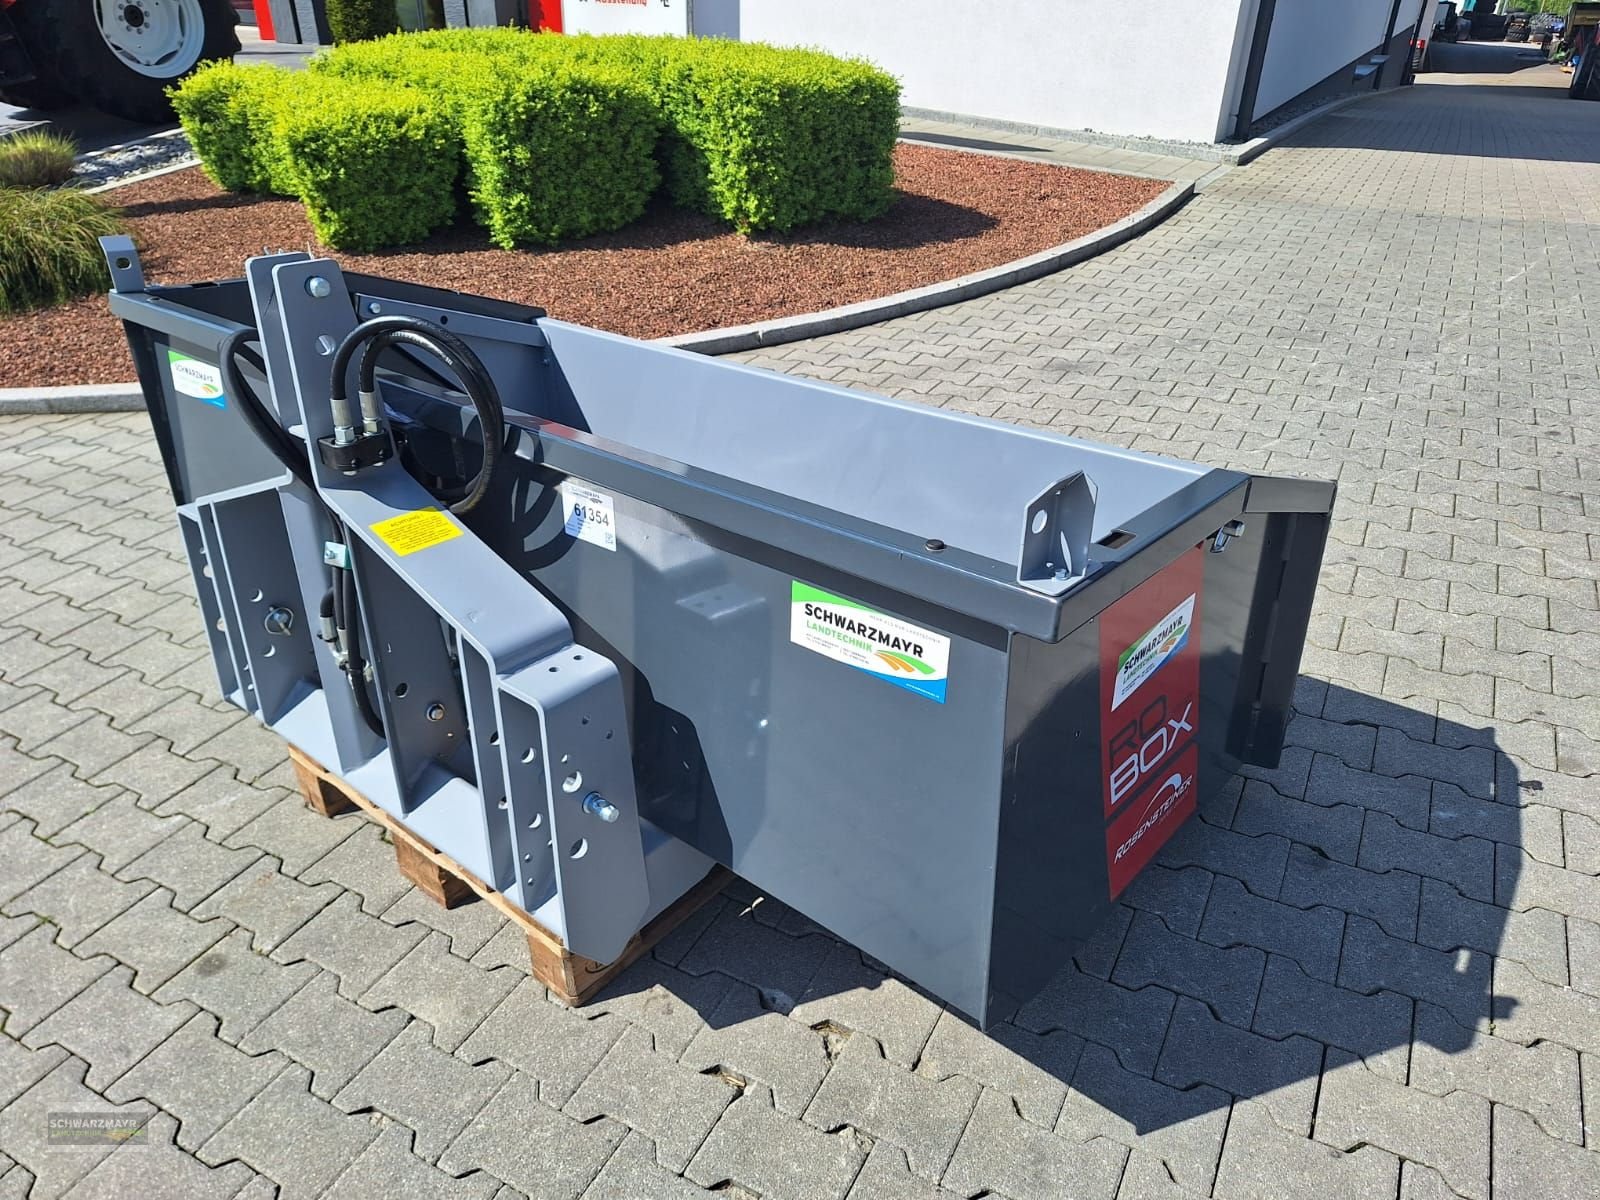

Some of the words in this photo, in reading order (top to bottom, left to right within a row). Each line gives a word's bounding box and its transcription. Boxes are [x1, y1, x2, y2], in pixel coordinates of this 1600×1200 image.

[574, 503, 609, 526] 61354
[804, 603, 924, 658] SCHWARZMAYR
[806, 620, 873, 653] LANDTECHNIK
[1123, 615, 1183, 674] SCHWARZMAYR
[1109, 694, 1168, 771] RO
[1110, 701, 1193, 805] BOX
[1113, 774, 1193, 865] ROSENSTEINER
